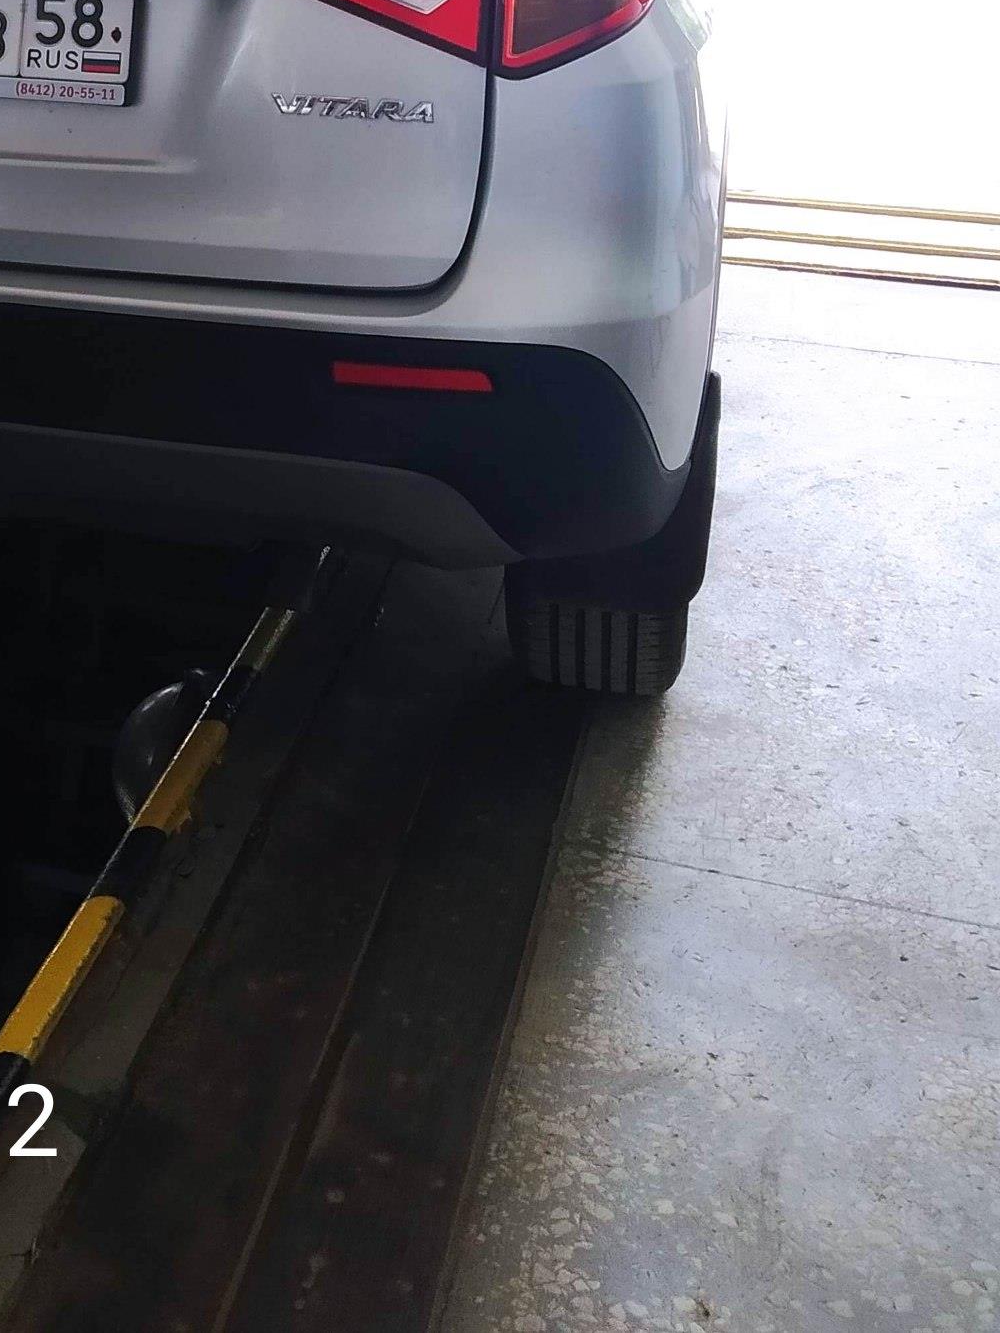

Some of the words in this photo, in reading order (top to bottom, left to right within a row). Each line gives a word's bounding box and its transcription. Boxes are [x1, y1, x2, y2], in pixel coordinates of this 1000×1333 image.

[27, 48, 79, 70] RUS
[15, 81, 56, 99] (8412)
[59, 85, 116, 101] 20-55-11
[271, 92, 435, 124] VITARA
